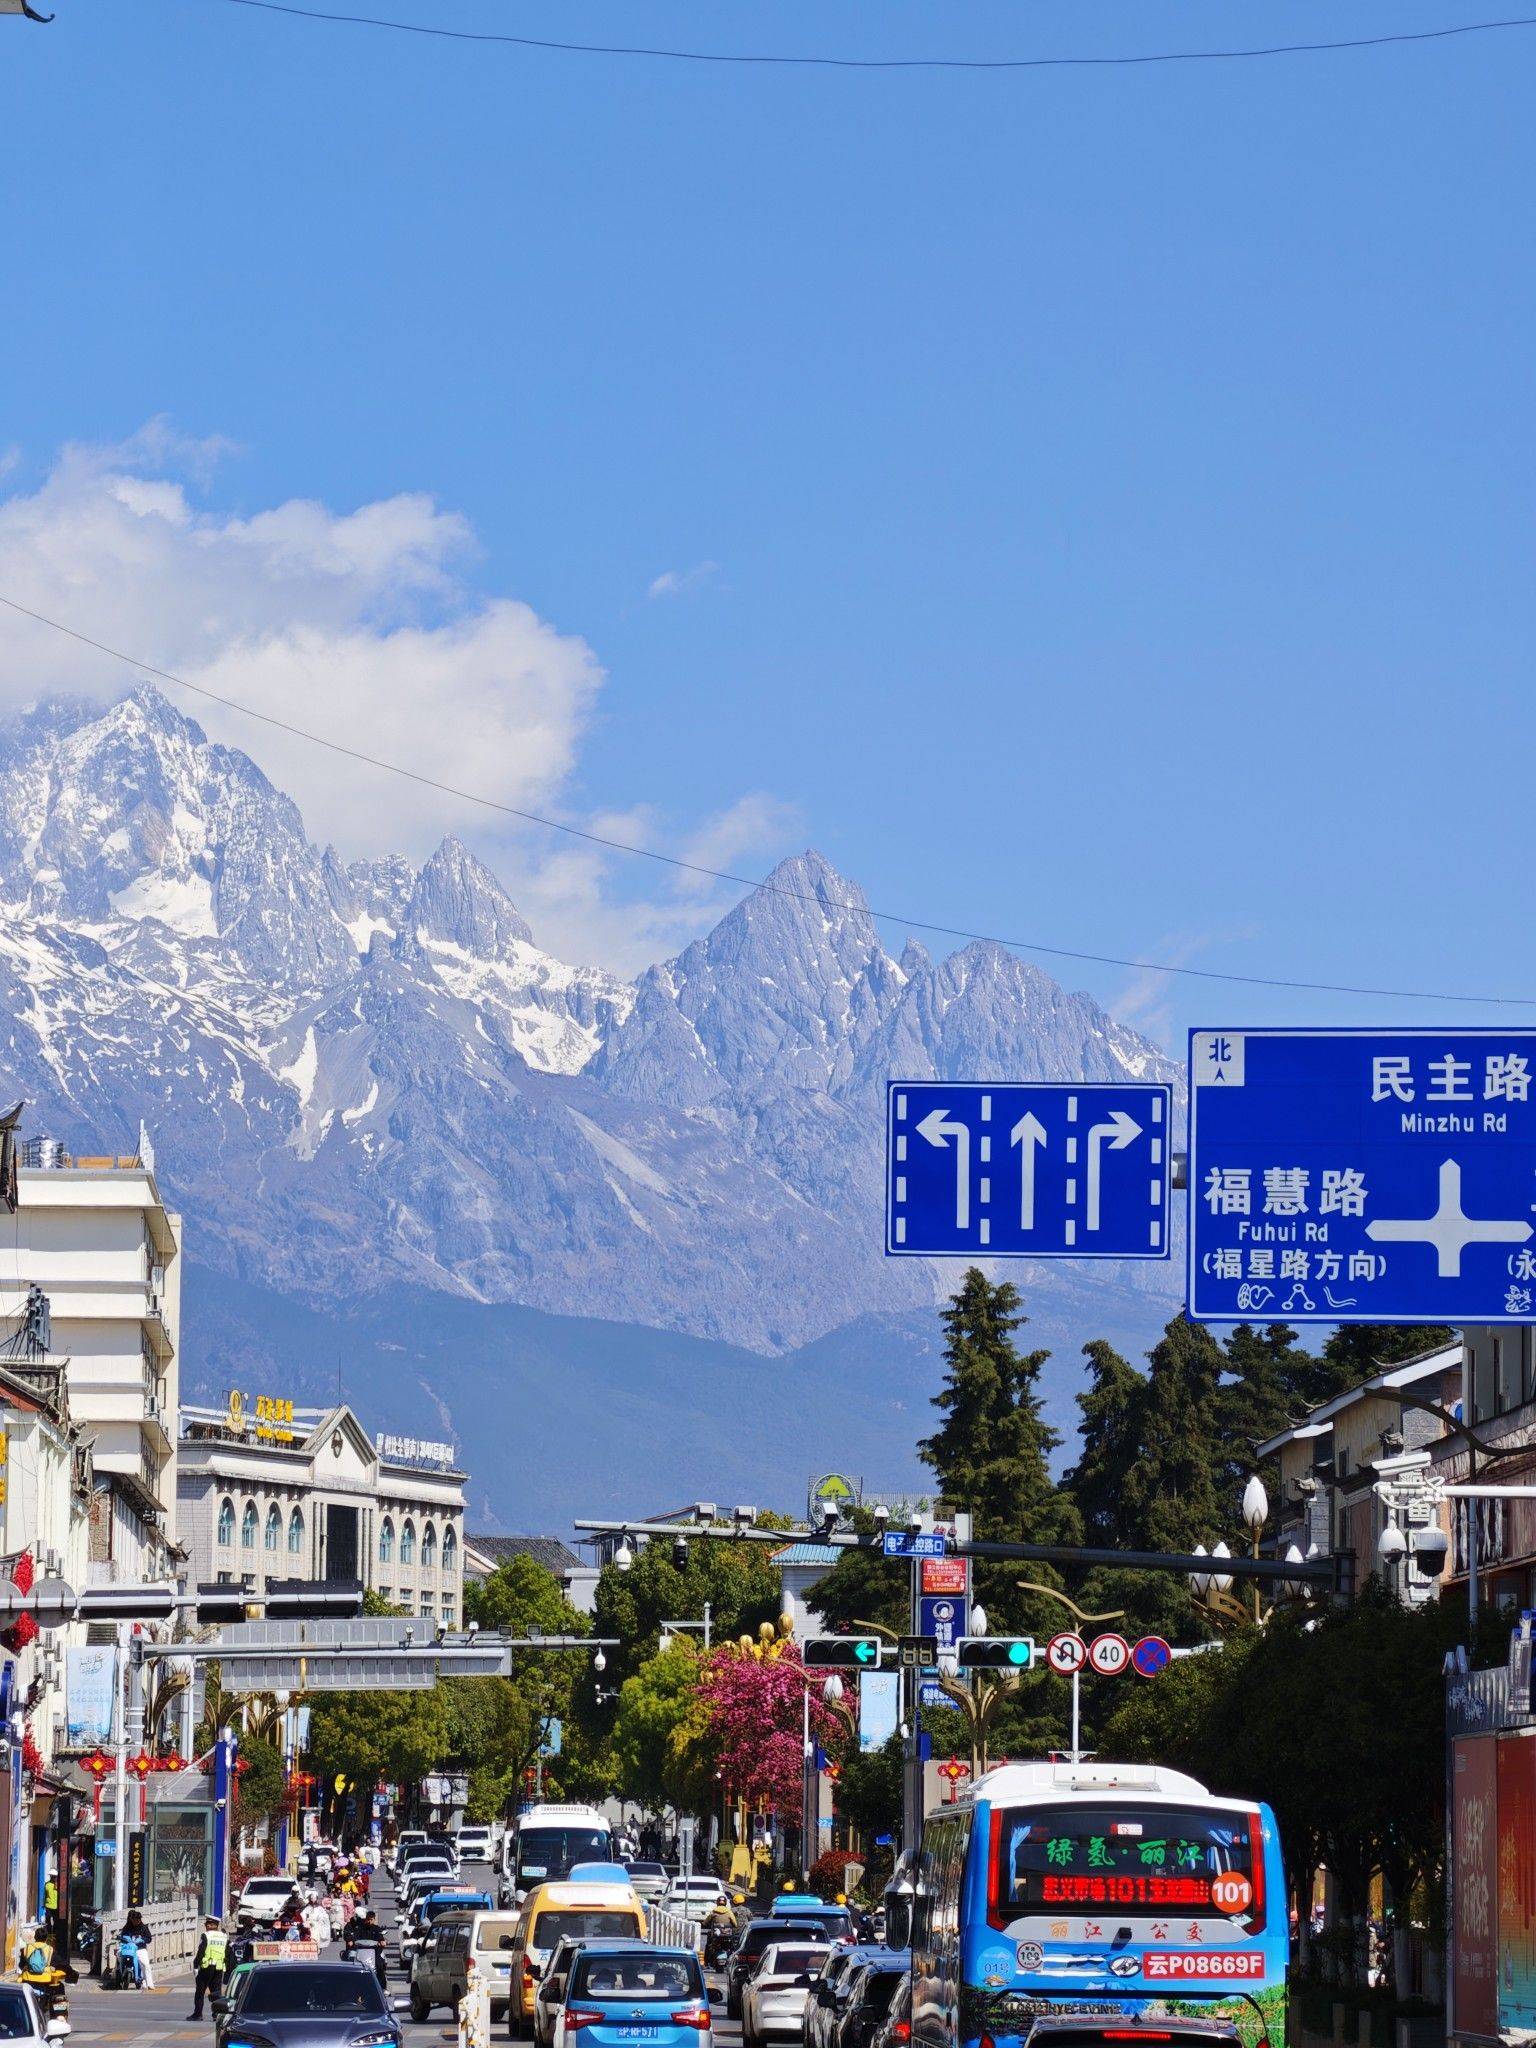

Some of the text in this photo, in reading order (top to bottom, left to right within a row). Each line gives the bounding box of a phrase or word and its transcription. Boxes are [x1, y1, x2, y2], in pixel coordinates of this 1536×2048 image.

[1208, 1037, 1232, 1062] 北
[1371, 1053, 1532, 1102] 民主路
[1401, 1113, 1507, 1133] Minzhu Rd
[1204, 1166, 1369, 1217] 福慧路
[1238, 1221, 1328, 1242] Fuhui Rd
[1202, 1247, 1387, 1282] (福星路方向)
[1099, 1646, 1120, 1662] 40
[1213, 1882, 1250, 1903] 101
[1147, 1955, 1262, 1975] 云P08669F
